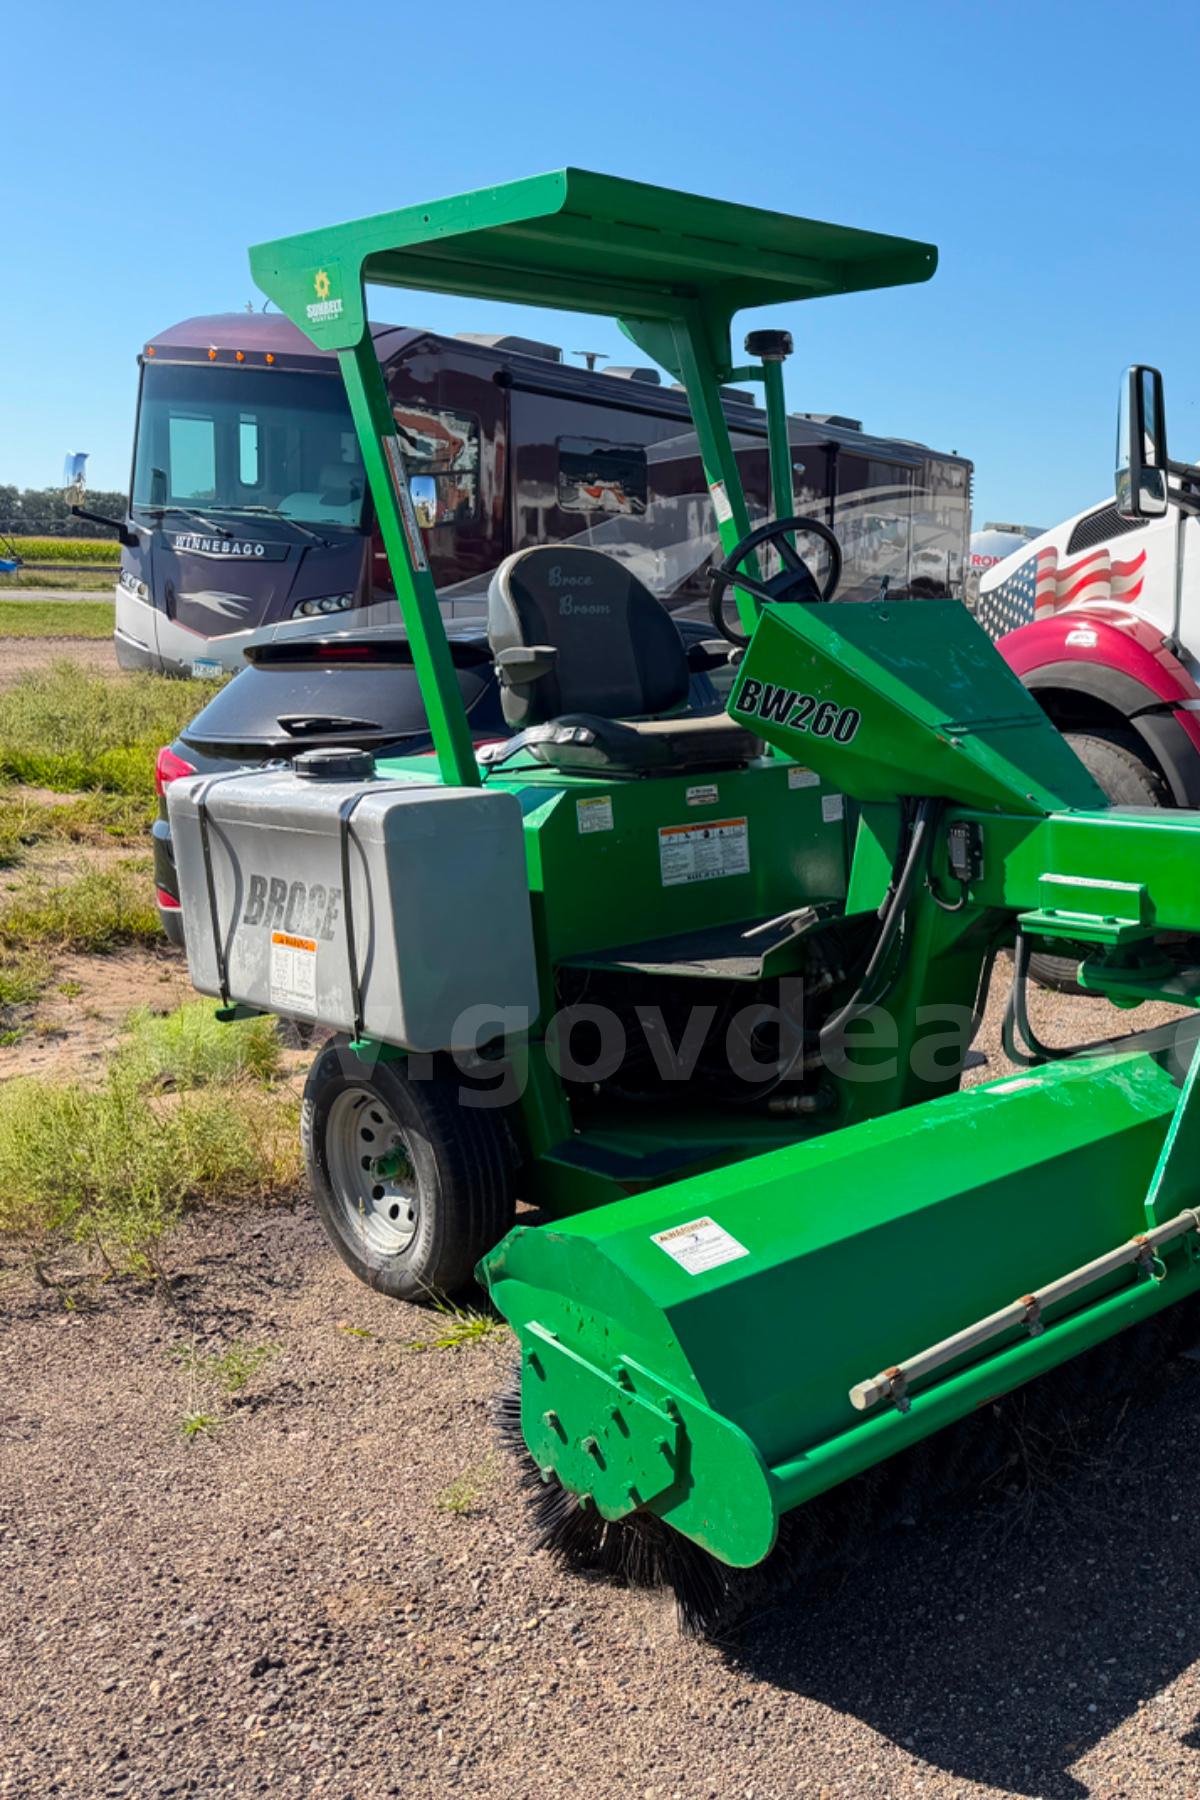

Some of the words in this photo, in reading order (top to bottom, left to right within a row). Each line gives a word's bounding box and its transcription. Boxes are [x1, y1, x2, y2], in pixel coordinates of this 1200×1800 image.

[175, 535, 265, 557] WINNEBAGO
[548, 566, 593, 588] Broce
[560, 594, 611, 616] Broom
[735, 677, 861, 744] BW260
[244, 873, 342, 942] BROCE
